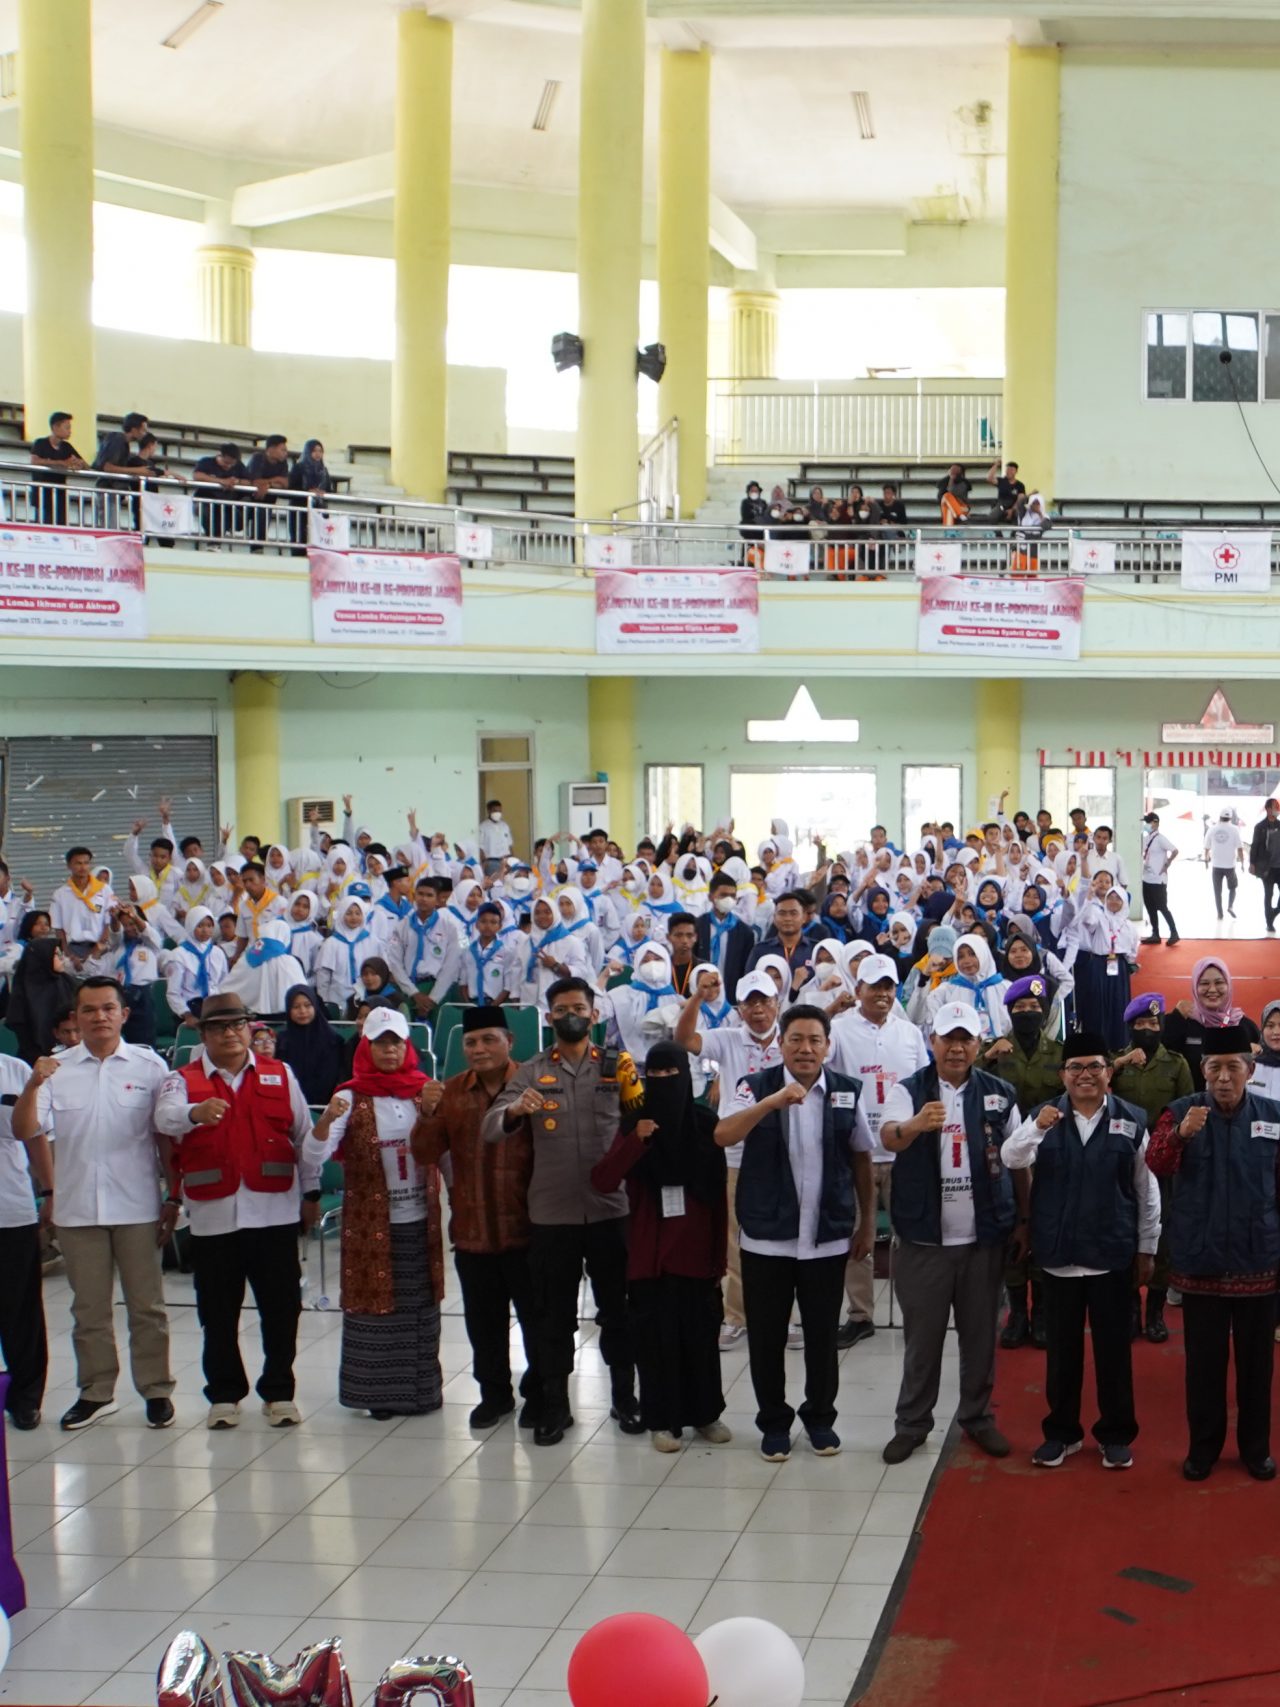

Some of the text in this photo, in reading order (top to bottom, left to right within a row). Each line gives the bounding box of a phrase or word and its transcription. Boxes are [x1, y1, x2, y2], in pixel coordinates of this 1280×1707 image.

[1214, 572, 1238, 584] PMI
[69, 601, 84, 609] dan
[86, 602, 116, 610] Akhwat
[978, 628, 1000, 636] Lomba
